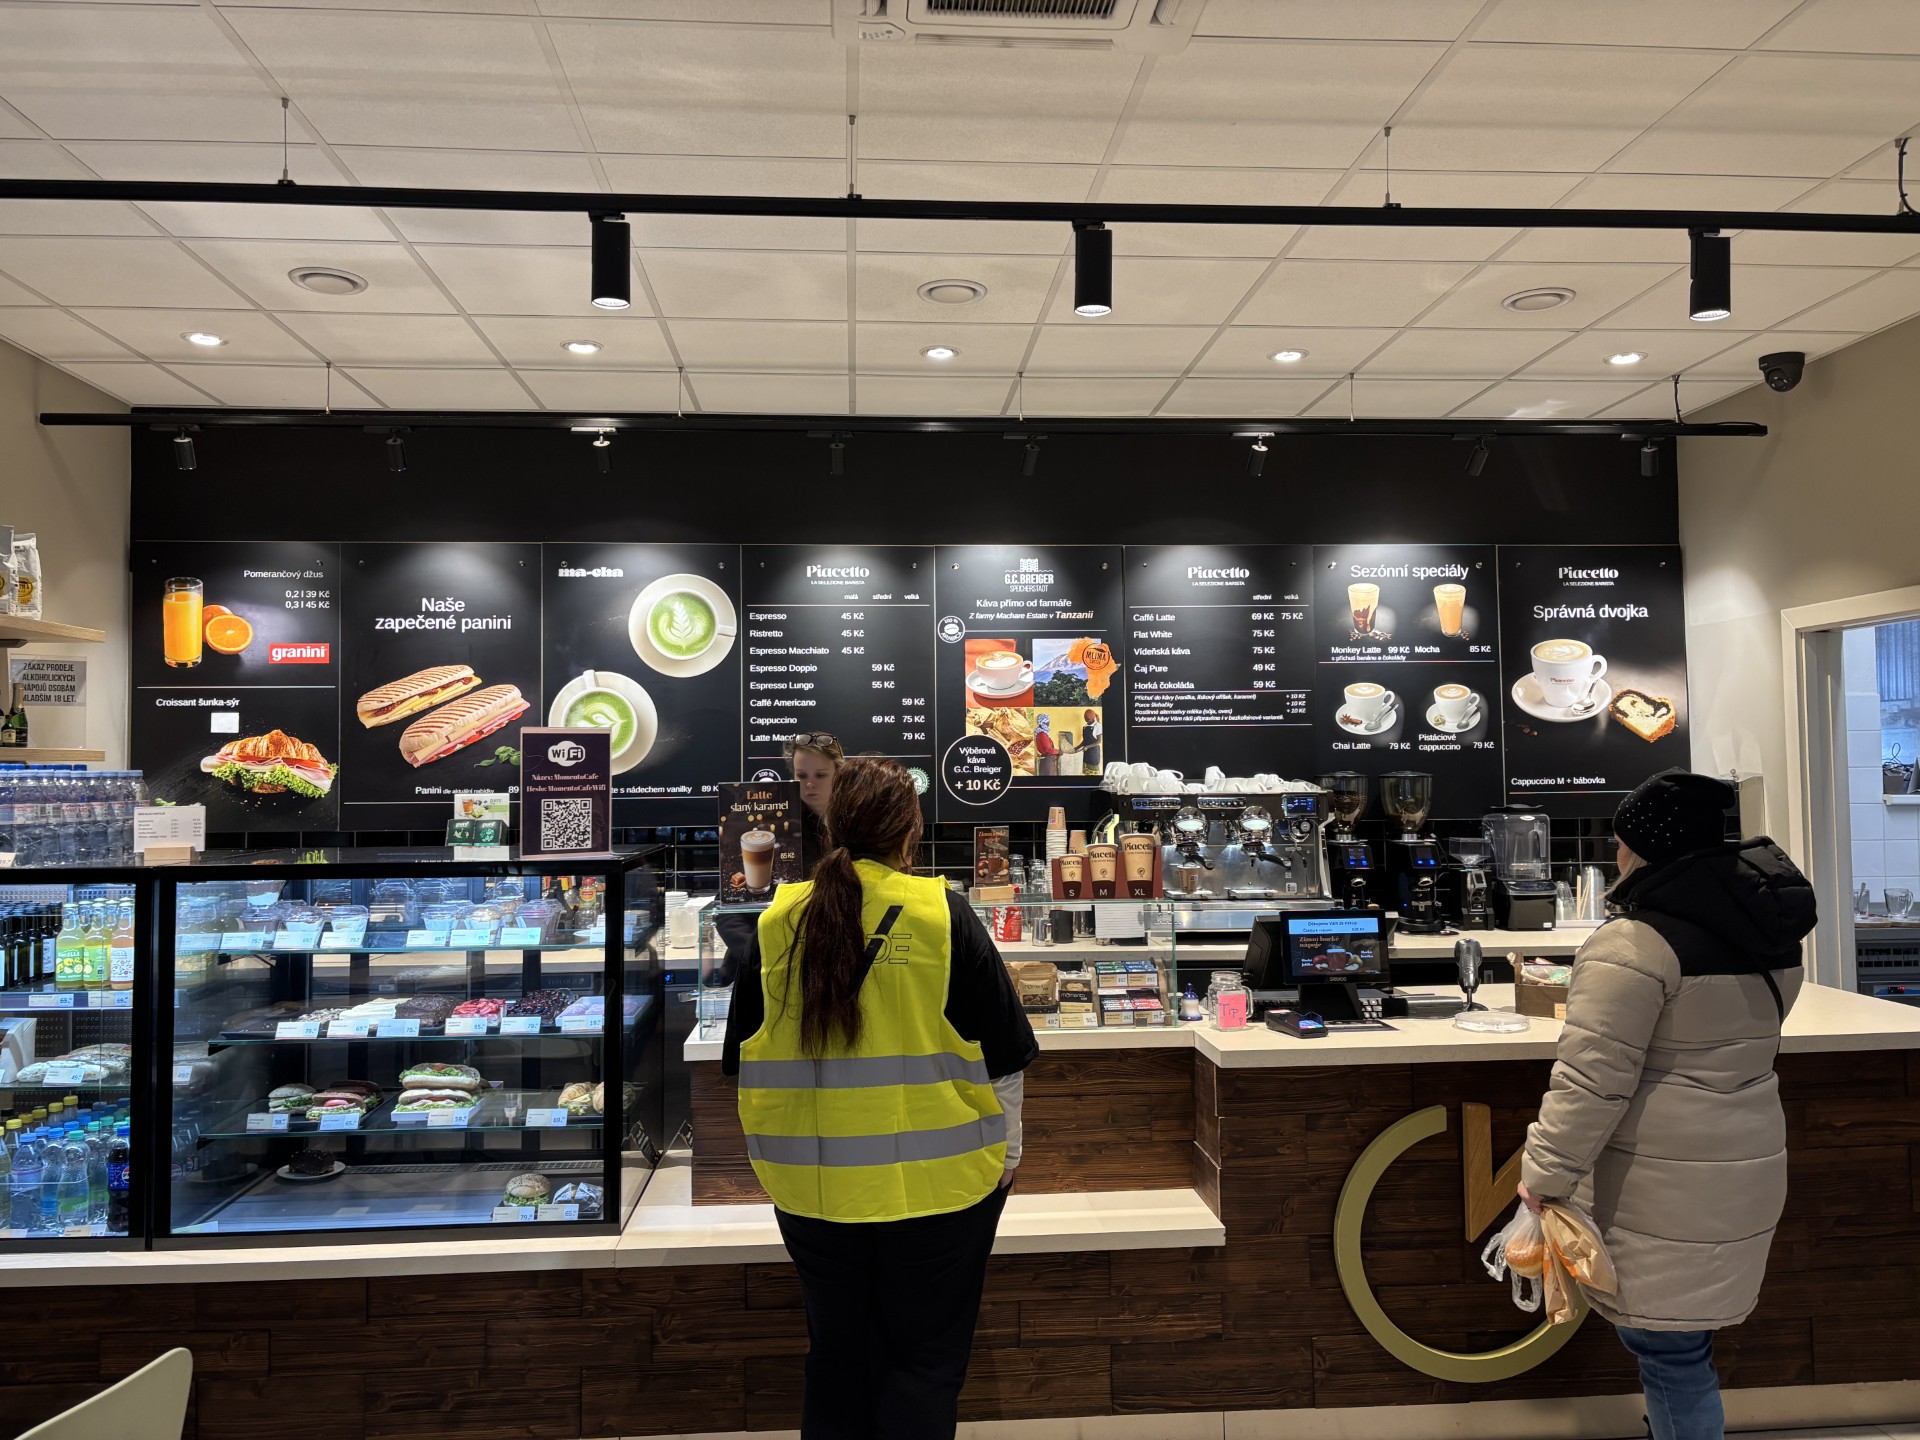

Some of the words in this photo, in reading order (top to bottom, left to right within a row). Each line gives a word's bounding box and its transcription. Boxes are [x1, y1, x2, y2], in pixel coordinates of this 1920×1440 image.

[243, 569, 301, 579] Pomerančový
[303, 569, 324, 579] džus
[558, 567, 624, 578] ma-cha
[806, 565, 870, 578] Piacetto
[1187, 566, 1250, 579] Piacetto
[1351, 564, 1408, 578] Sezónní
[1412, 564, 1469, 580] speciály
[1558, 567, 1619, 579] Piacetto
[1005, 574, 1020, 584] G.C.
[1020, 574, 1054, 584] BREIGER
[1009, 585, 1049, 593] SPEICHERSTADT
[285, 590, 299, 600] 0,2
[305, 590, 317, 599] 39
[318, 590, 330, 599] Kč
[285, 601, 299, 610] 0,3
[305, 600, 317, 610] 45
[318, 600, 330, 610] Kč
[421, 597, 465, 612] Naše
[976, 599, 998, 607] Káva
[1000, 599, 1025, 609] přímo
[1026, 599, 1038, 607] od
[1039, 599, 1072, 607] farmáře
[749, 613, 787, 621] Espresso
[841, 612, 852, 620] 45
[853, 612, 865, 620] Kč
[975, 612, 995, 620] farmy
[1055, 611, 1094, 619] Tanzanii
[1133, 613, 1155, 622] Caffé
[1156, 613, 1176, 621] Latte
[1533, 604, 1595, 621] Správná
[1599, 604, 1648, 621] dvojka
[375, 614, 456, 633] zapečené
[461, 614, 512, 633] panini
[749, 630, 783, 638] Ristretto
[1133, 631, 1149, 639] Flat
[1149, 630, 1173, 638] White
[272, 645, 326, 662] granini
[749, 647, 787, 656] Espresso
[1086, 650, 1107, 661] MLIMA
[1134, 647, 1170, 656] Vídeňská
[1171, 647, 1191, 655] káva
[1331, 646, 1360, 656] Monkey
[1362, 646, 1382, 654] Latte
[1388, 646, 1398, 654] 99
[1399, 645, 1410, 654] Kč
[1414, 645, 1441, 653] Mocha
[1469, 645, 1480, 653] 85
[1480, 645, 1492, 653] Kč
[23, 662, 45, 671] ZÁKAZ
[46, 663, 75, 672] PRODEJE
[749, 664, 787, 673] Espresso
[789, 664, 818, 673] Doppio
[1134, 663, 1148, 674] Čaj
[22, 673, 76, 682] ALKOHOLICKÝCH
[48, 683, 76, 692] OSOBÁM
[749, 682, 787, 691] Espresso
[789, 682, 814, 691] Lungo
[872, 681, 882, 689] 55
[883, 681, 895, 689] Kč
[1134, 682, 1158, 690] Horká
[1159, 681, 1195, 689] čokoláda
[54, 694, 62, 702] 18
[62, 695, 77, 703] LET.
[156, 698, 197, 707] Croissant
[198, 697, 240, 708] šunka-sýr
[750, 699, 772, 707] Caffé
[773, 699, 817, 707] Americano
[902, 698, 913, 706] 59
[914, 698, 926, 706] Kč
[750, 716, 798, 726] Cappuccino
[750, 734, 771, 742] Latte
[959, 747, 996, 755] Výběrová
[1332, 742, 1351, 750] Chai
[1352, 742, 1371, 750] Latte
[1389, 742, 1399, 750] 79
[1400, 742, 1411, 750] Kč
[1418, 743, 1461, 752] cappuccino
[1472, 741, 1483, 749] 79
[1484, 741, 1495, 749] Kč
[552, 748, 582, 759] WiFi
[966, 756, 986, 764] káva
[953, 765, 972, 773] G.C.
[973, 765, 1002, 775] Breiger
[531, 773, 553, 781] Název:
[554, 773, 599, 781] MomentoCafe
[1511, 777, 1556, 787] Cappuccino
[1557, 777, 1565, 785] M
[1573, 776, 1606, 785] bábovka
[415, 786, 442, 795] Panini
[508, 785, 520, 794] 89
[626, 785, 665, 794] nádechem
[666, 785, 693, 794] vanilky
[983, 779, 1001, 791] Kč
[746, 791, 773, 800] Latte
[730, 801, 752, 814] slaný
[753, 800, 789, 811] karamel
[780, 852, 788, 860] 85
[788, 852, 796, 860] Kč
[1069, 889, 1075, 897] S
